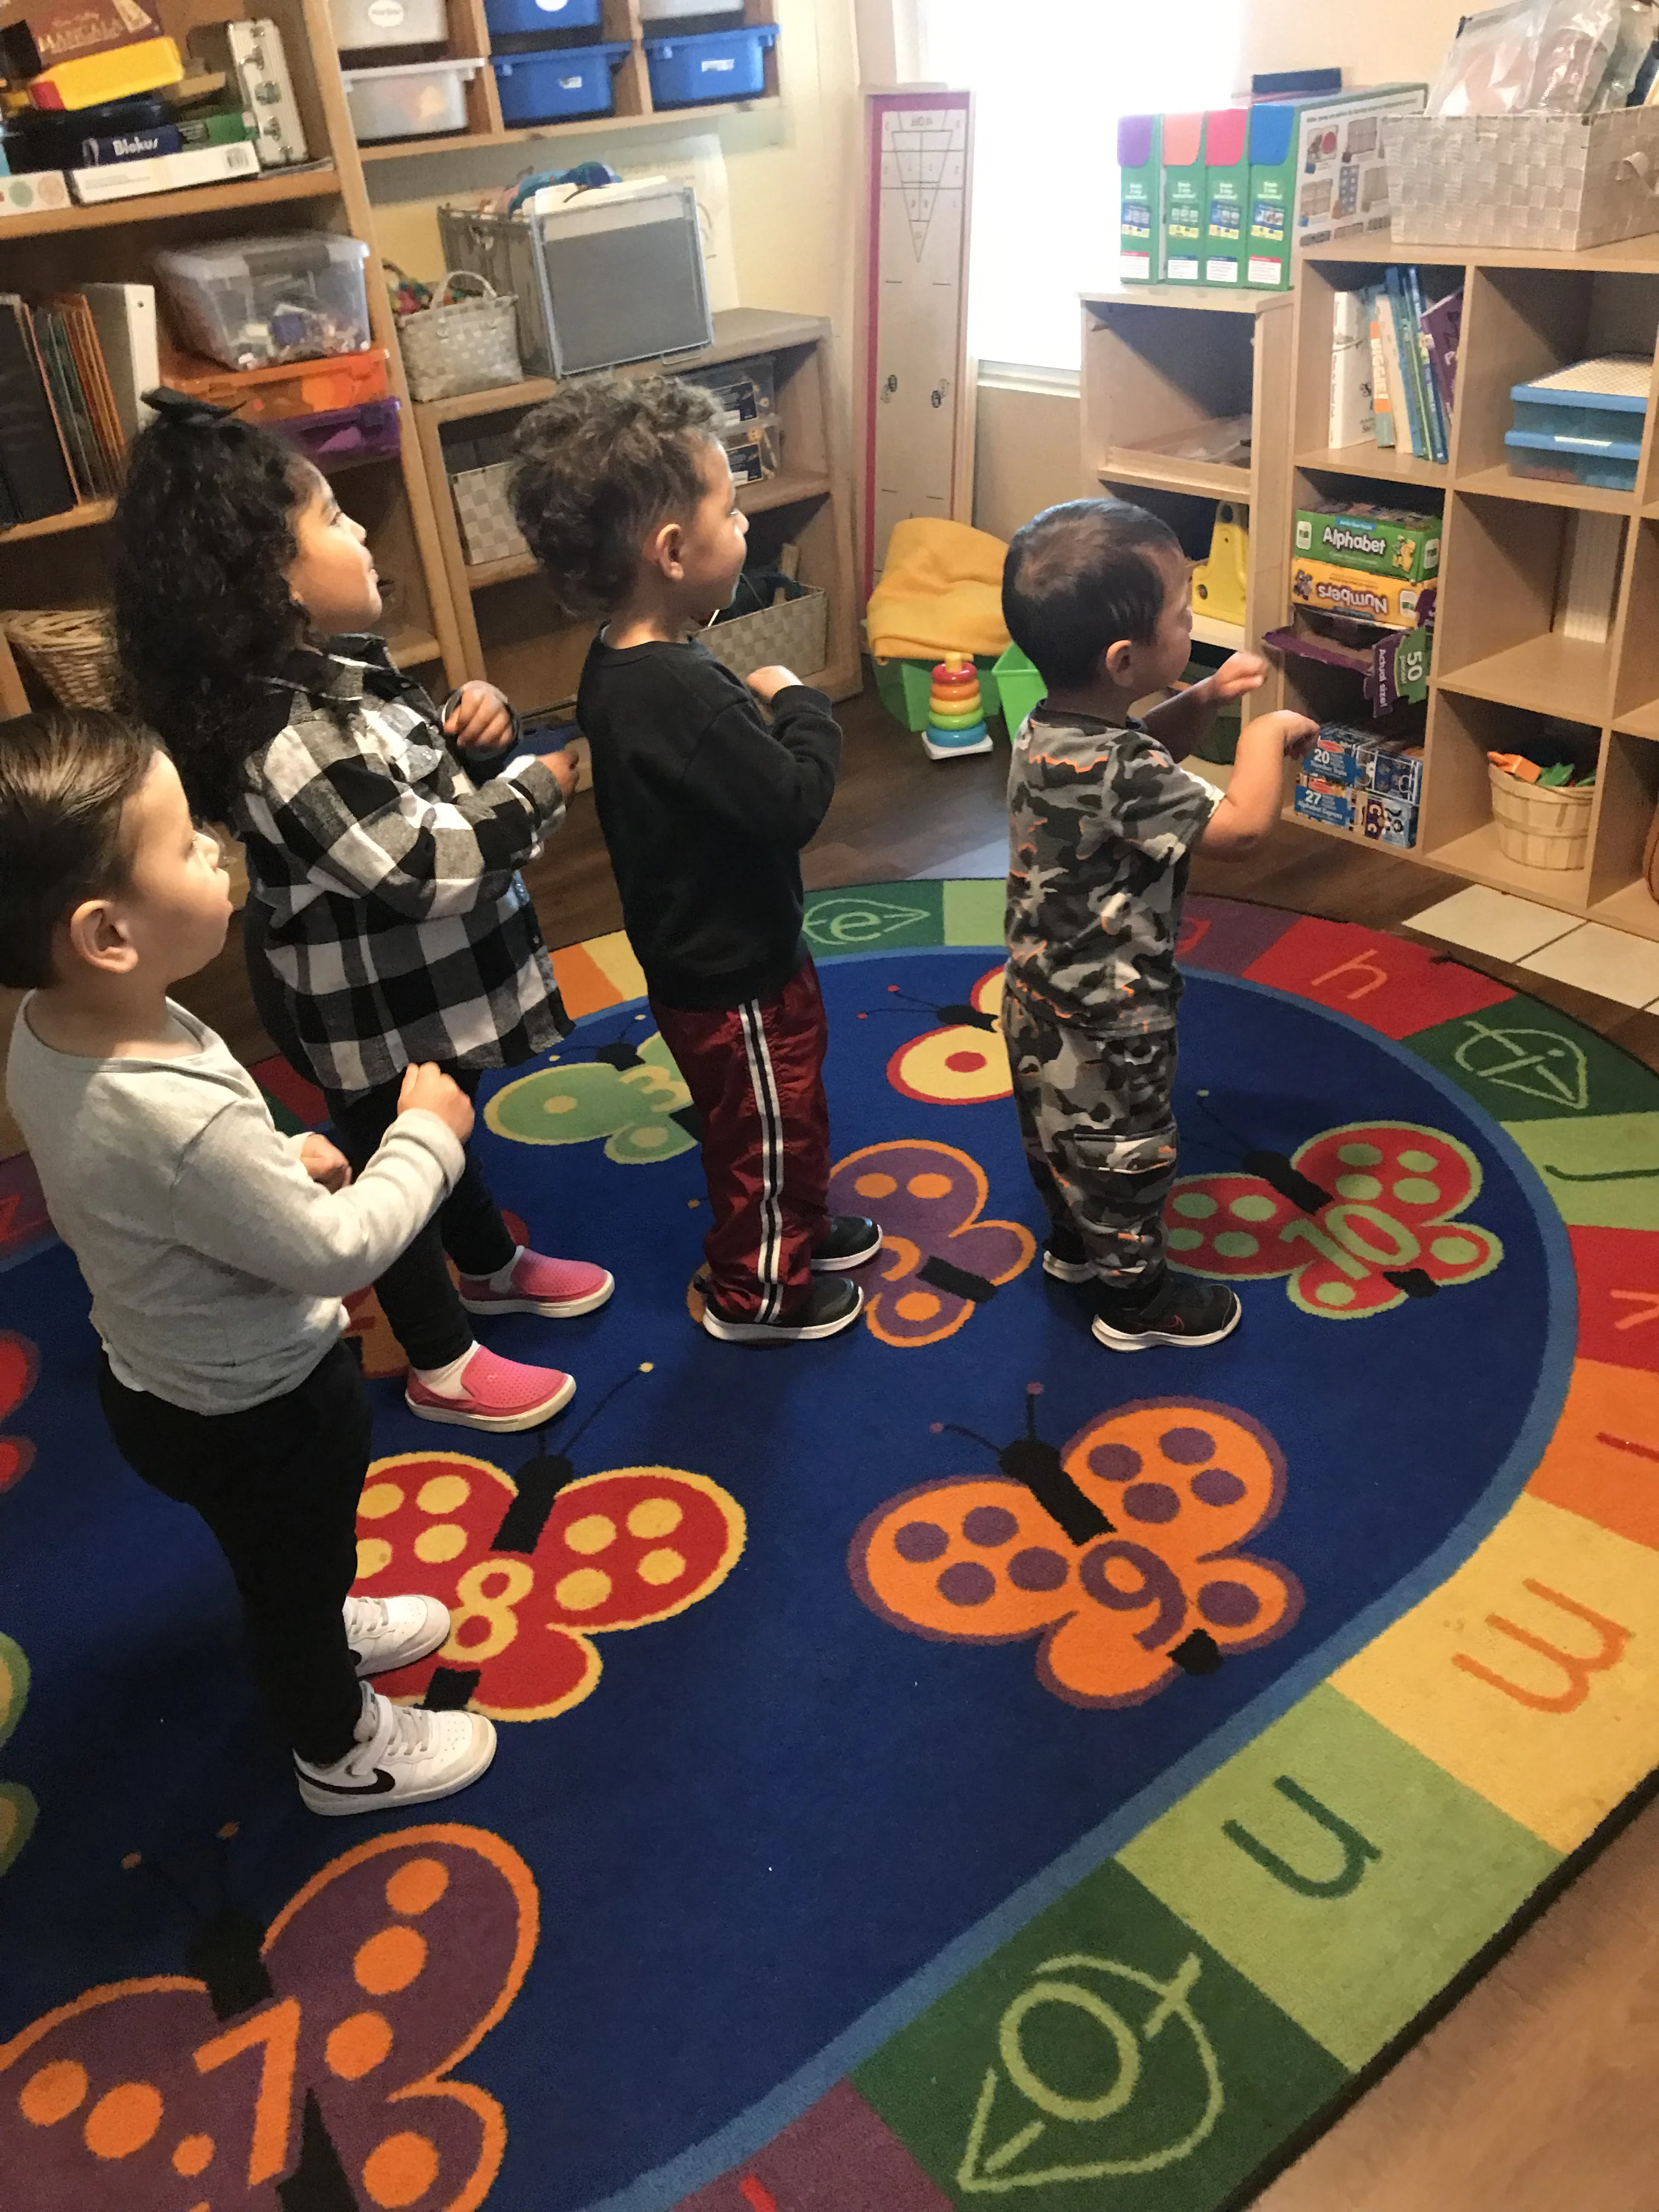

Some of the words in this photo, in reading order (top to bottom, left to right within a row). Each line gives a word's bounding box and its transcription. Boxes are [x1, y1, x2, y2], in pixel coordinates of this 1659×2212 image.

[112, 136, 158, 156] Blokus
[1323, 526, 1386, 555] Alphabet
[1318, 585, 1389, 614] Numbers
[1379, 648, 1387, 682] Actual
[1407, 651, 1423, 682] 50
[1313, 748, 1330, 764] 20
[1305, 789, 1322, 805] 27
[830, 912, 882, 943] e
[1311, 949, 1387, 1000] h
[1279, 1204, 1421, 1280] 10
[439, 1558, 534, 1662] 8
[1079, 1540, 1188, 1652] 9
[1451, 1578, 1636, 1714] m
[1221, 1775, 1383, 1899] n
[192, 1995, 301, 2188] 7
